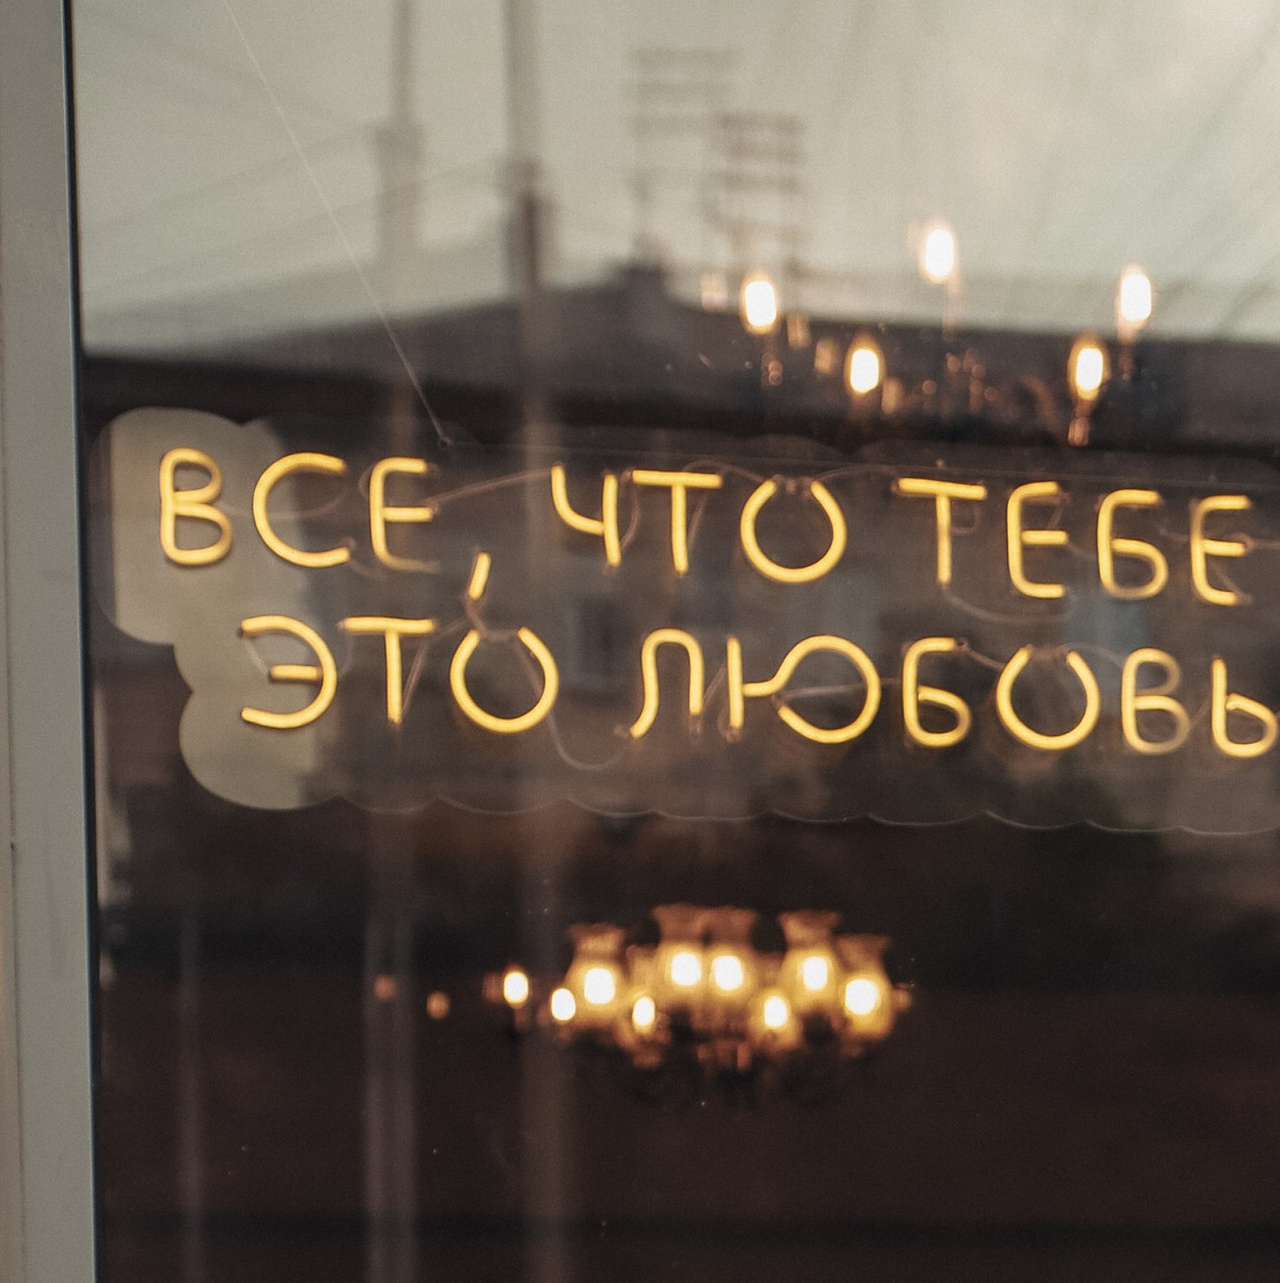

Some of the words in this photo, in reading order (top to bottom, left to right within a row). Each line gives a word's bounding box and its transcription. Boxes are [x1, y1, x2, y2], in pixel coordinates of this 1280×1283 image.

[158, 446, 491, 602] ВСЕ,
[550, 465, 847, 584] ЧТО
[897, 477, 1252, 608] ТЕБЕ
[240, 614, 560, 734] ЭТО
[629, 628, 1279, 760] ЛЮБОВЬ
